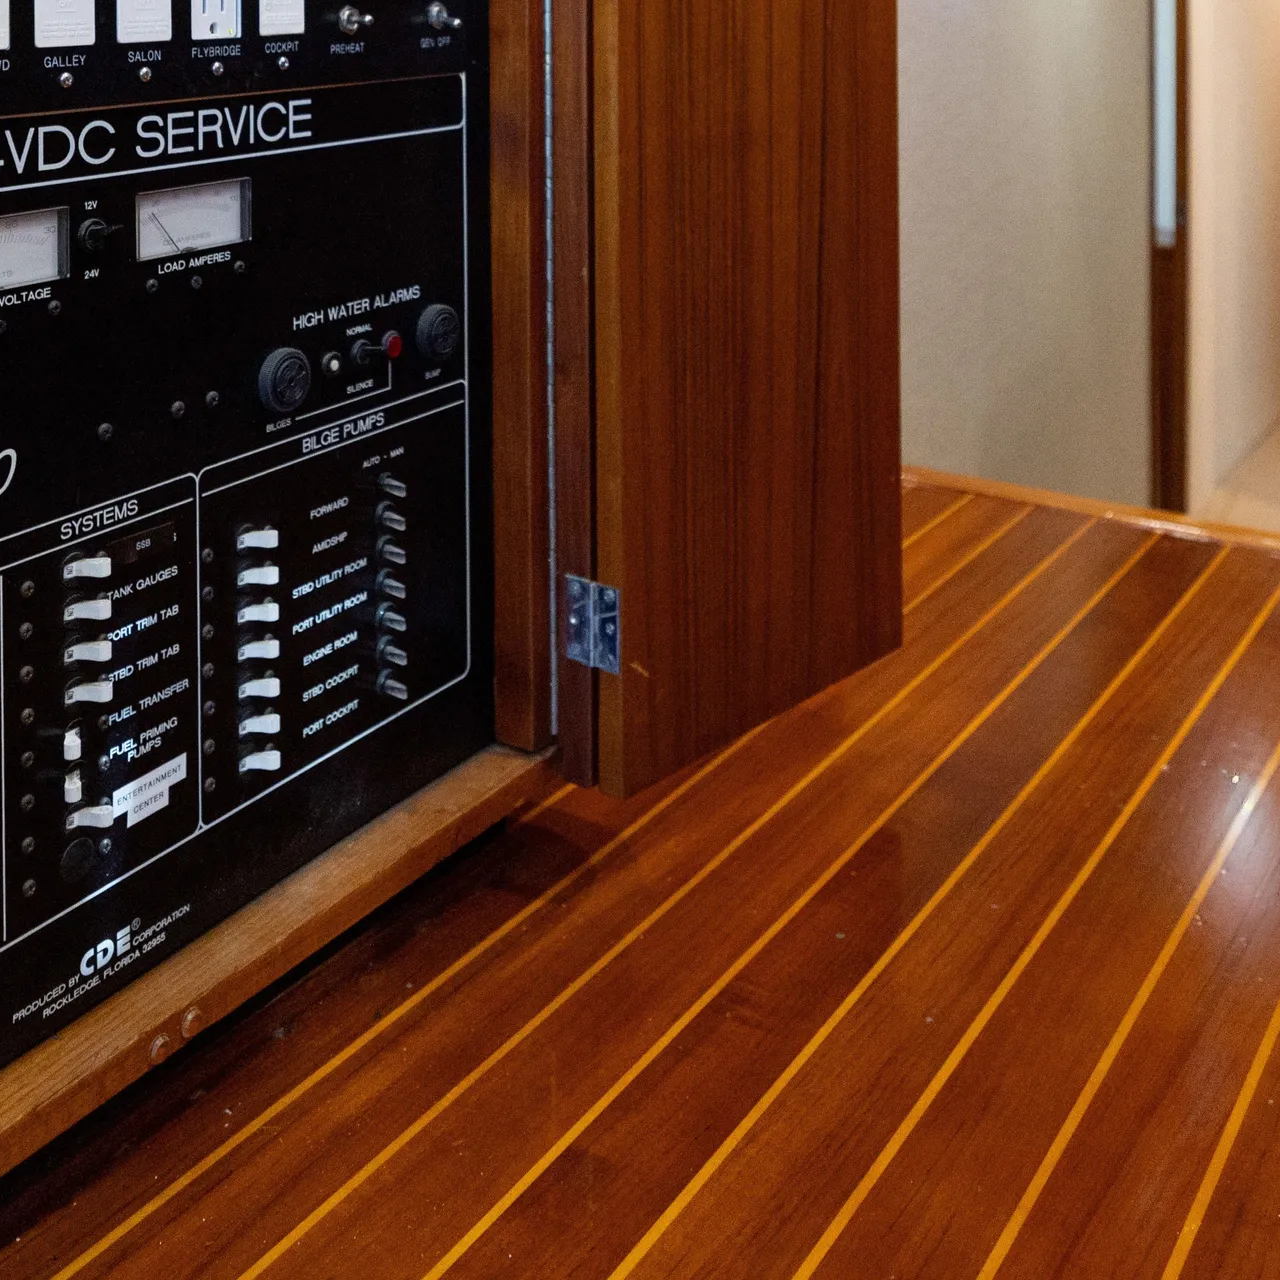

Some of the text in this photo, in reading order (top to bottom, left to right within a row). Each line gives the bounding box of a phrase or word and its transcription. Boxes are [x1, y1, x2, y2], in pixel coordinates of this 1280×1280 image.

[44, 54, 87, 68] GALLEY
[127, 50, 162, 63] SALON
[191, 44, 242, 58] FLYBRIDGE
[264, 40, 300, 53] COCKPIT
[330, 42, 365, 54] PREHEAT
[136, 98, 313, 159] SERVICE
[83, 200, 98, 210] 12V
[83, 268, 100, 280] 24V
[157, 251, 231, 275] LOAD AMPERES
[292, 285, 421, 331] HIGH WATER ALARMS
[346, 324, 373, 336] NORMAL
[346, 379, 374, 394] SILENCE
[266, 418, 292, 433] BILGES
[302, 412, 385, 453] BILGE PUMPS
[362, 446, 405, 469] AUTO MAN
[60, 499, 139, 540] SYSTEMS
[309, 496, 349, 520] FORWARD
[135, 538, 152, 551] SSB
[312, 531, 348, 554] AMIDSHIP
[106, 565, 179, 602] TANK GAUGES
[292, 556, 368, 599] STBD UTILITY ROOM
[107, 604, 179, 641] PORT TRIM TAB
[292, 591, 368, 636] PORT UTILITY ROOM
[108, 643, 180, 683] STBD TRIM TAB
[302, 630, 359, 667] ENGINE ROOM
[302, 663, 360, 703] STBD COCKPIT
[108, 678, 190, 727] FUEL TRANSFER
[302, 698, 360, 739] PORT COCKPIT
[109, 716, 178, 760] FUEL PRIMING
[127, 736, 162, 763] PUMPS
[116, 763, 183, 806] ENTERTAINMENT
[133, 791, 165, 814] CENTER
[12, 982, 67, 1024] PRODUCED
[68, 973, 81, 988] BY
[132, 903, 191, 947] CORPORATION
[103, 949, 141, 980] FLORIDA
[142, 932, 166, 954] 32955
